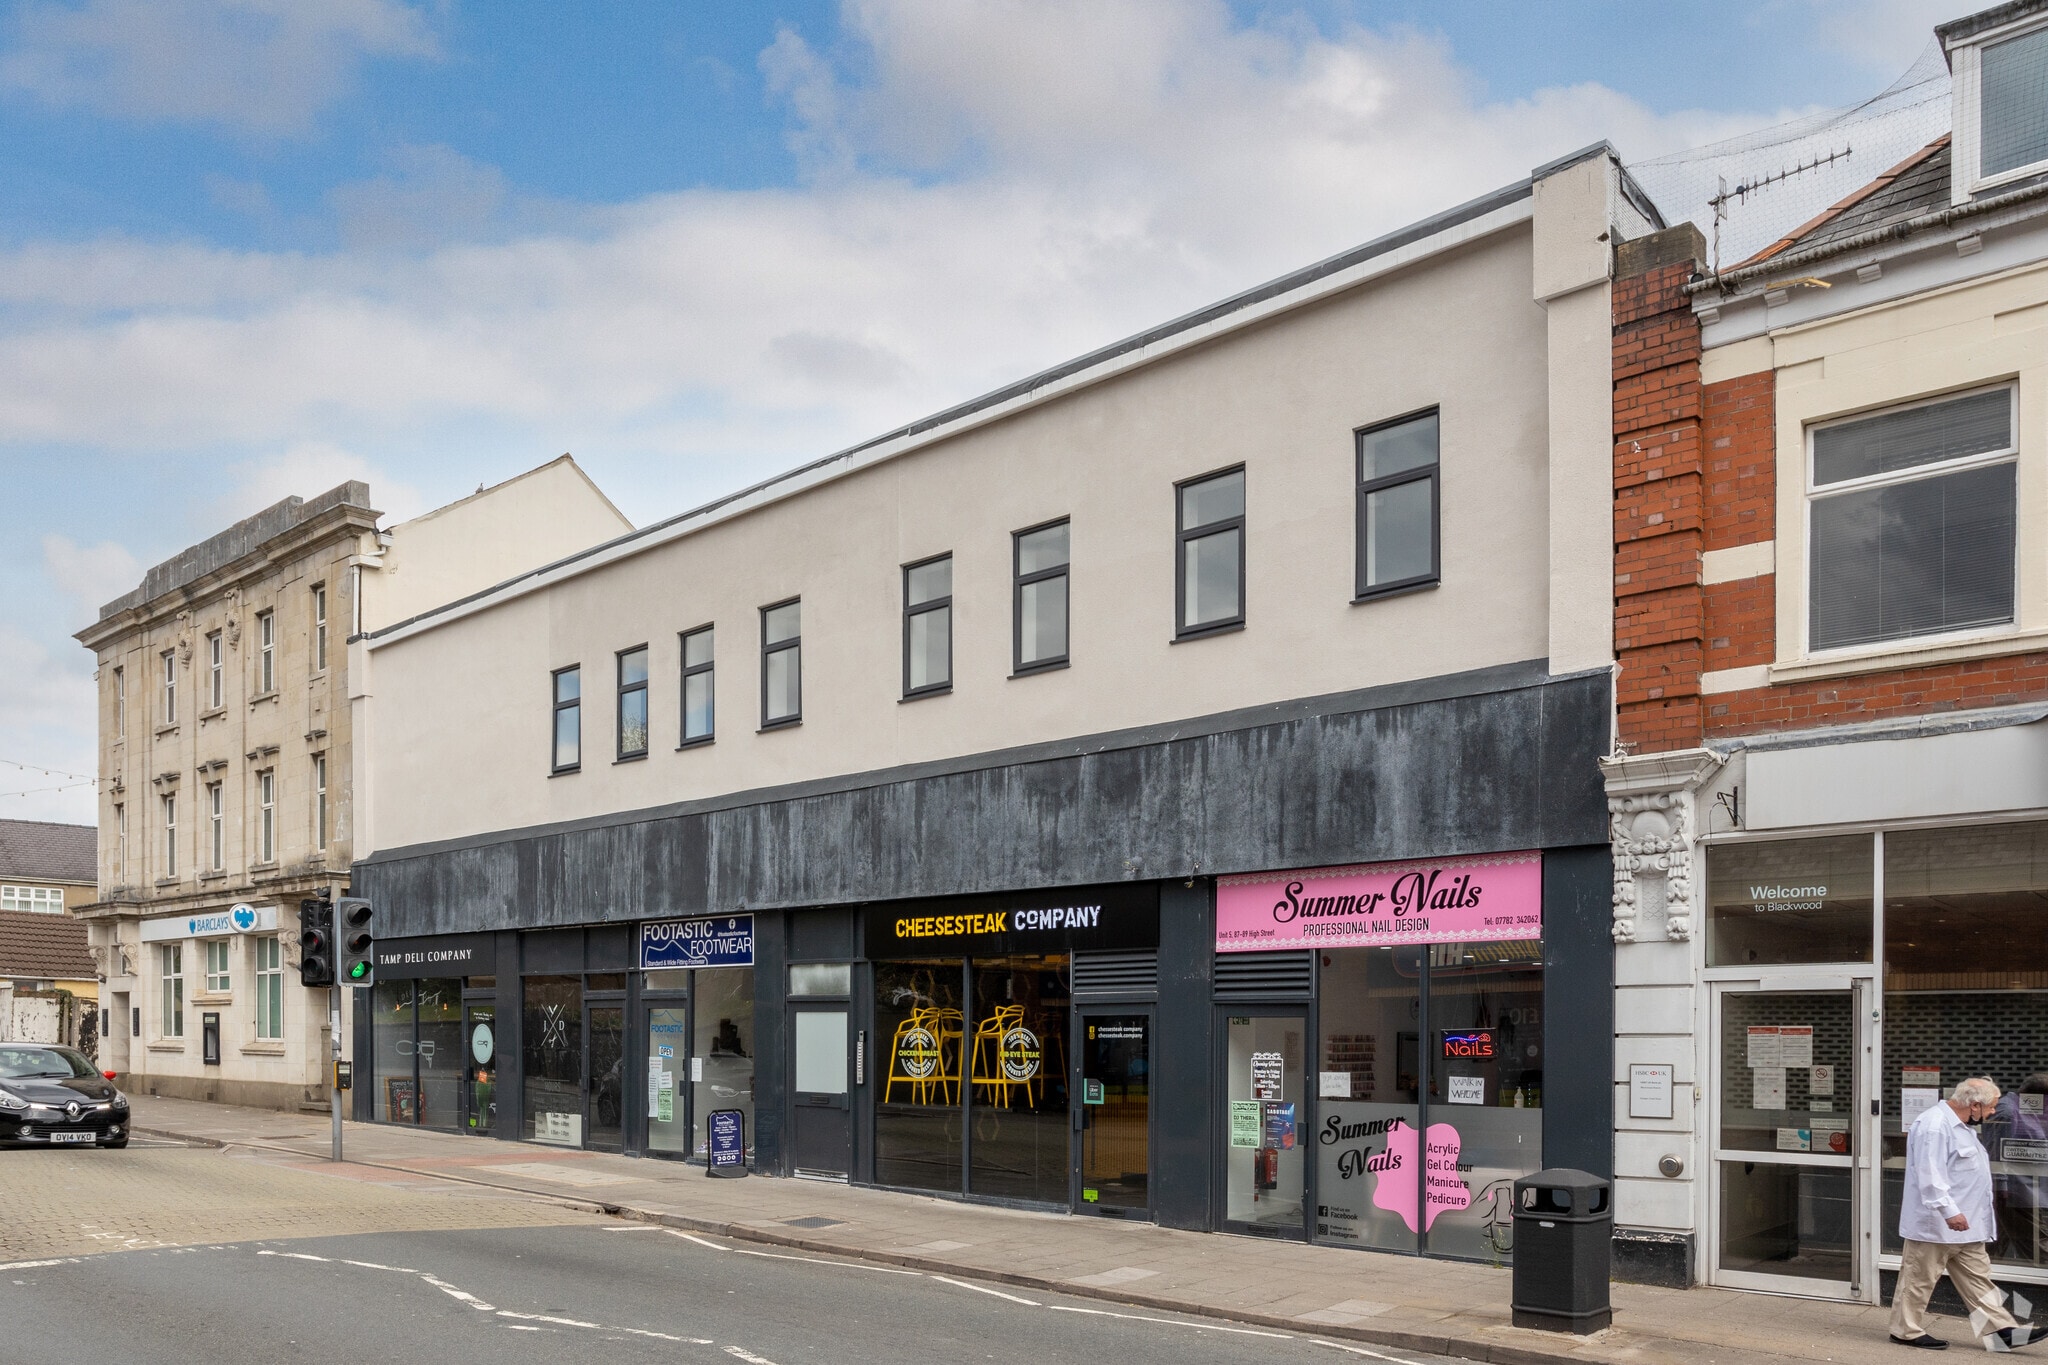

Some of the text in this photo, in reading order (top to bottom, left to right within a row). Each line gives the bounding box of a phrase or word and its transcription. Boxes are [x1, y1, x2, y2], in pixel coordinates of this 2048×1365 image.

[1273, 870, 1482, 923] Summer Nails
[1750, 885, 1827, 899] Welcome
[1755, 901, 1822, 912] to Blackwood
[197, 916, 229, 931] BARCLAYS
[896, 905, 1101, 938] CHEESESTEAK COMPANY
[1303, 917, 1429, 936] PROFESSIONAL NAIL DESIGN
[1484, 915, 1539, 926] Tel: 07782 342062
[643, 920, 713, 941] FOOTASTIC
[1218, 931, 1229, 939] Unit
[1234, 930, 1248, 938] 87-89
[1249, 930, 1260, 939] High
[1260, 929, 1275, 937] Street
[690, 938, 752, 955] FOOTWEAR
[380, 949, 472, 964] TAMP DELI COMPANY
[651, 1024, 683, 1033] FOOTASTIC
[1319, 1115, 1406, 1145] Summer
[1427, 1143, 1459, 1156] Acrylic
[1337, 1146, 1402, 1179] Nails
[1427, 1159, 1474, 1172] Gel Colour
[1427, 1176, 1469, 1189] Manicure
[1427, 1192, 1467, 1206] Pedicure
[1330, 1211, 1359, 1220] Facebook
[1330, 1231, 1359, 1239] Instagram
